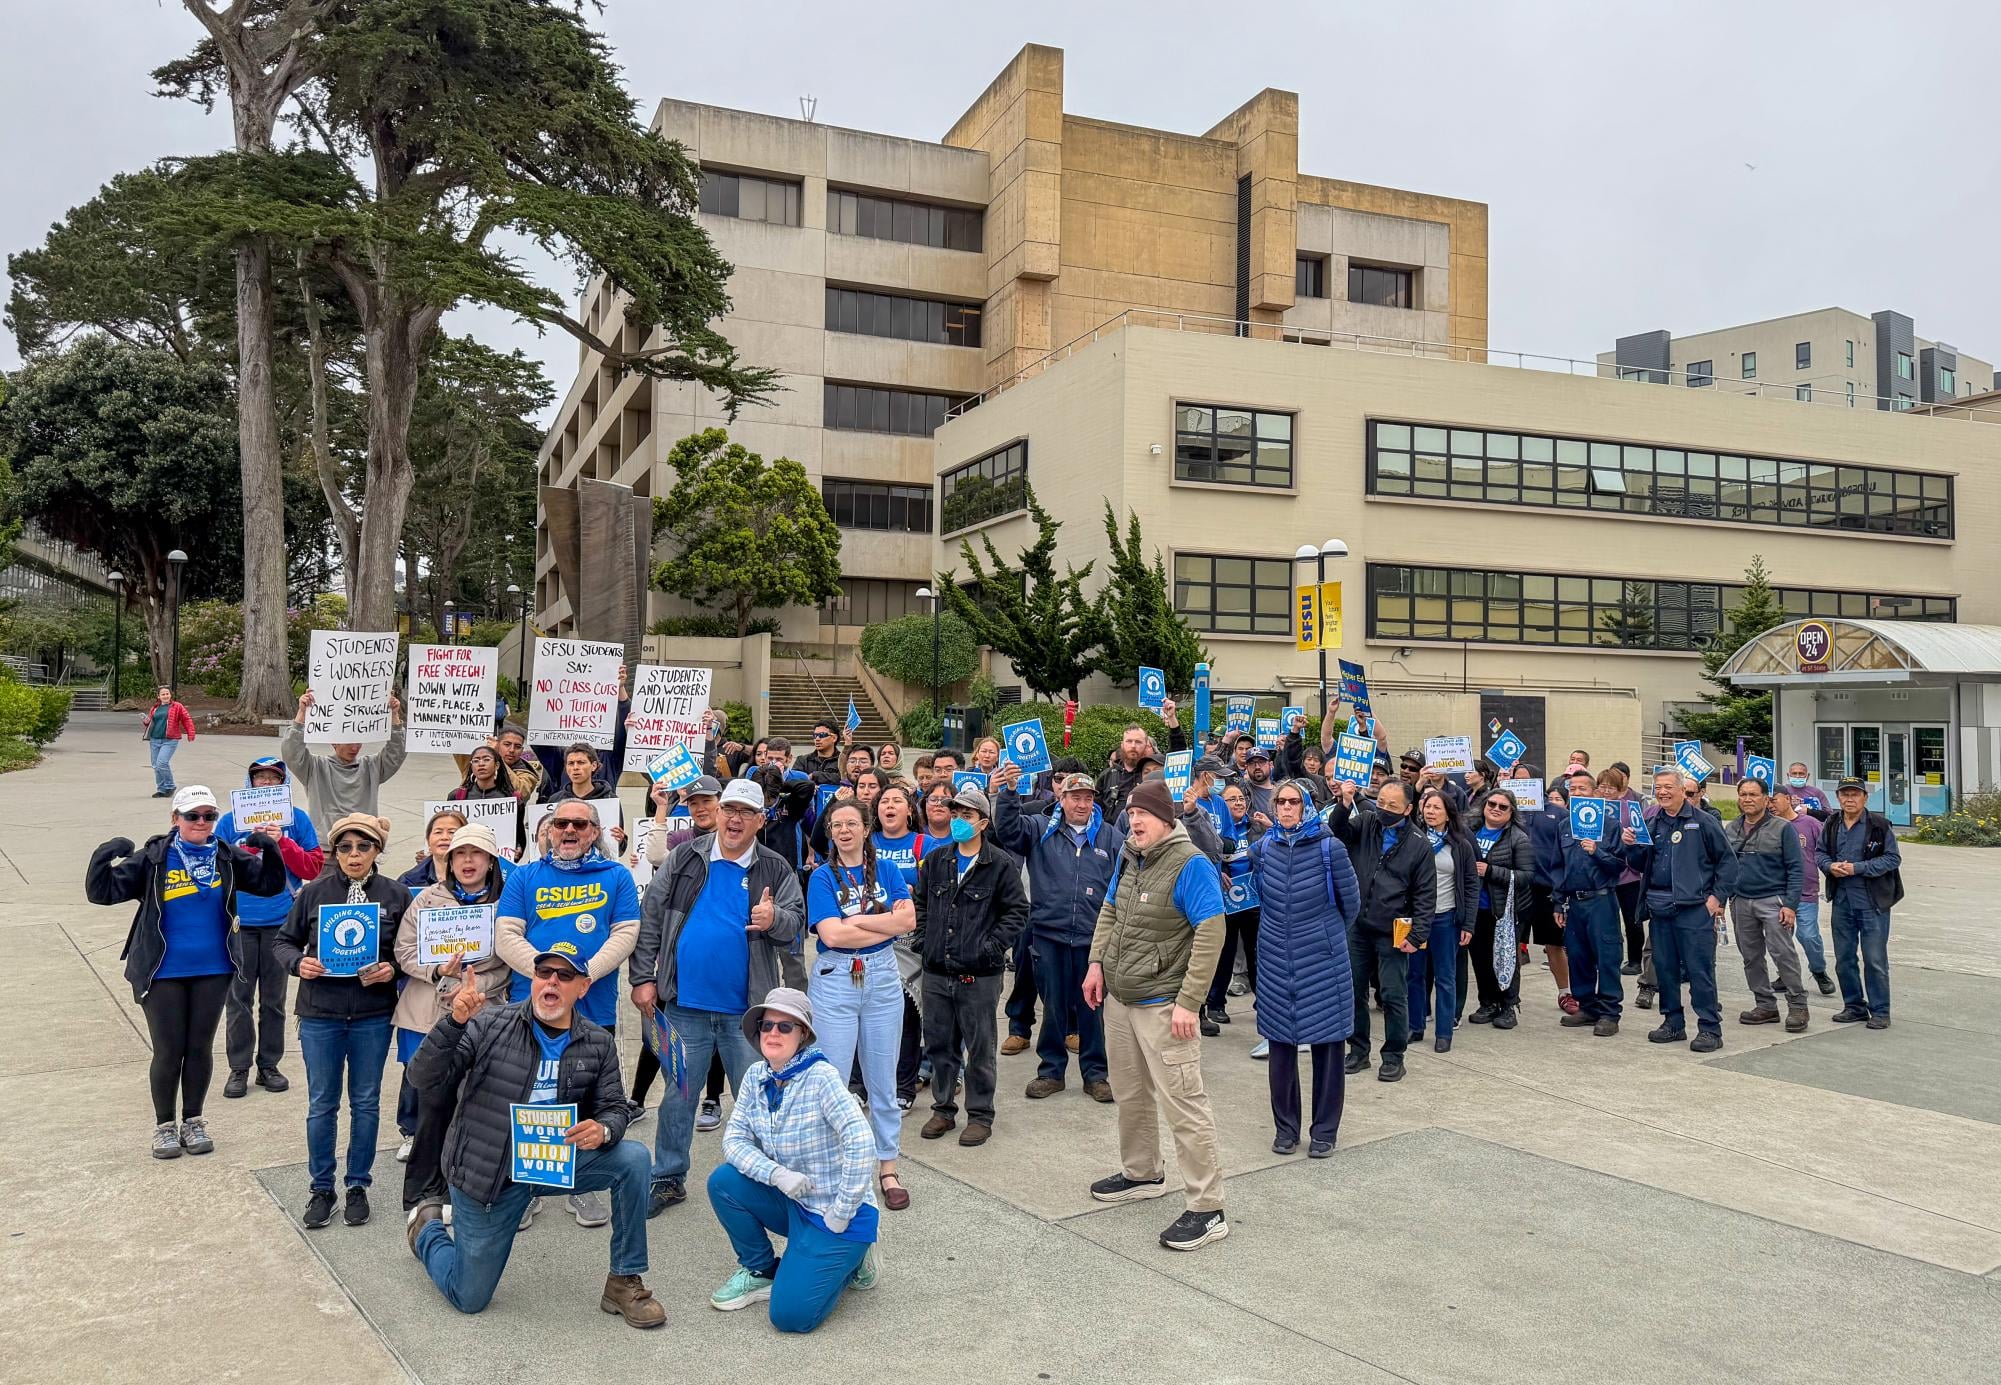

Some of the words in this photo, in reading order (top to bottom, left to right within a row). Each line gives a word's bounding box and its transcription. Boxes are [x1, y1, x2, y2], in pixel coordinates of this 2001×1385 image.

[1302, 594, 1312, 642] SFSU
[1800, 632, 1823, 644] OPEN
[326, 638, 396, 658] STUDENTS
[427, 648, 453, 661] FIGHT
[456, 649, 472, 661] FOR
[542, 642, 575, 656] SFSU
[580, 644, 624, 658] STUDENTS
[1806, 644, 1818, 656] 24
[330, 660, 394, 680] WORKERS
[418, 664, 440, 678] FREE
[444, 664, 486, 680] SPEECH!
[566, 662, 592, 674] SAY:
[648, 670, 705, 682] STUDENTS
[332, 681, 388, 702] UNITE!
[418, 682, 446, 696] DOWN
[452, 683, 480, 697] WITH
[536, 679, 552, 692] NO
[559, 679, 591, 694] CLASS
[594, 684, 618, 696] CUTS
[637, 684, 660, 696] AND
[664, 683, 708, 696] WORKERS
[310, 704, 334, 718] ONE
[443, 699, 474, 712] PLACE,
[546, 699, 562, 712] NO
[570, 700, 607, 713] TUITION
[644, 697, 692, 716] UNITE!
[307, 722, 332, 734] ONE
[342, 716, 388, 733] FIGHT!
[413, 712, 458, 724] MANNER"
[461, 714, 492, 727] DIKTAT
[560, 715, 602, 728] HIKES!
[635, 718, 664, 732] SAME
[666, 720, 706, 734] STRUGGLE
[529, 732, 540, 741] SF
[544, 732, 600, 742] INTERNATIONALIST
[634, 734, 662, 746] SAME
[1342, 738, 1373, 752] STUDENT
[628, 754, 642, 766] SF
[1344, 748, 1368, 758] WORK
[1338, 758, 1369, 772] UNION
[1340, 768, 1364, 779] WORK
[474, 801, 516, 818] STUDENT
[536, 882, 600, 902] CSUEU
[323, 910, 352, 933] BUILDING
[354, 910, 376, 930] POWER
[332, 946, 367, 956] TOGETHER
[431, 941, 480, 955] UNION!
[518, 1110, 568, 1126] STUDENT
[522, 1126, 566, 1136] WORK
[520, 1142, 570, 1161] UNION
[522, 1160, 564, 1172] WORK
